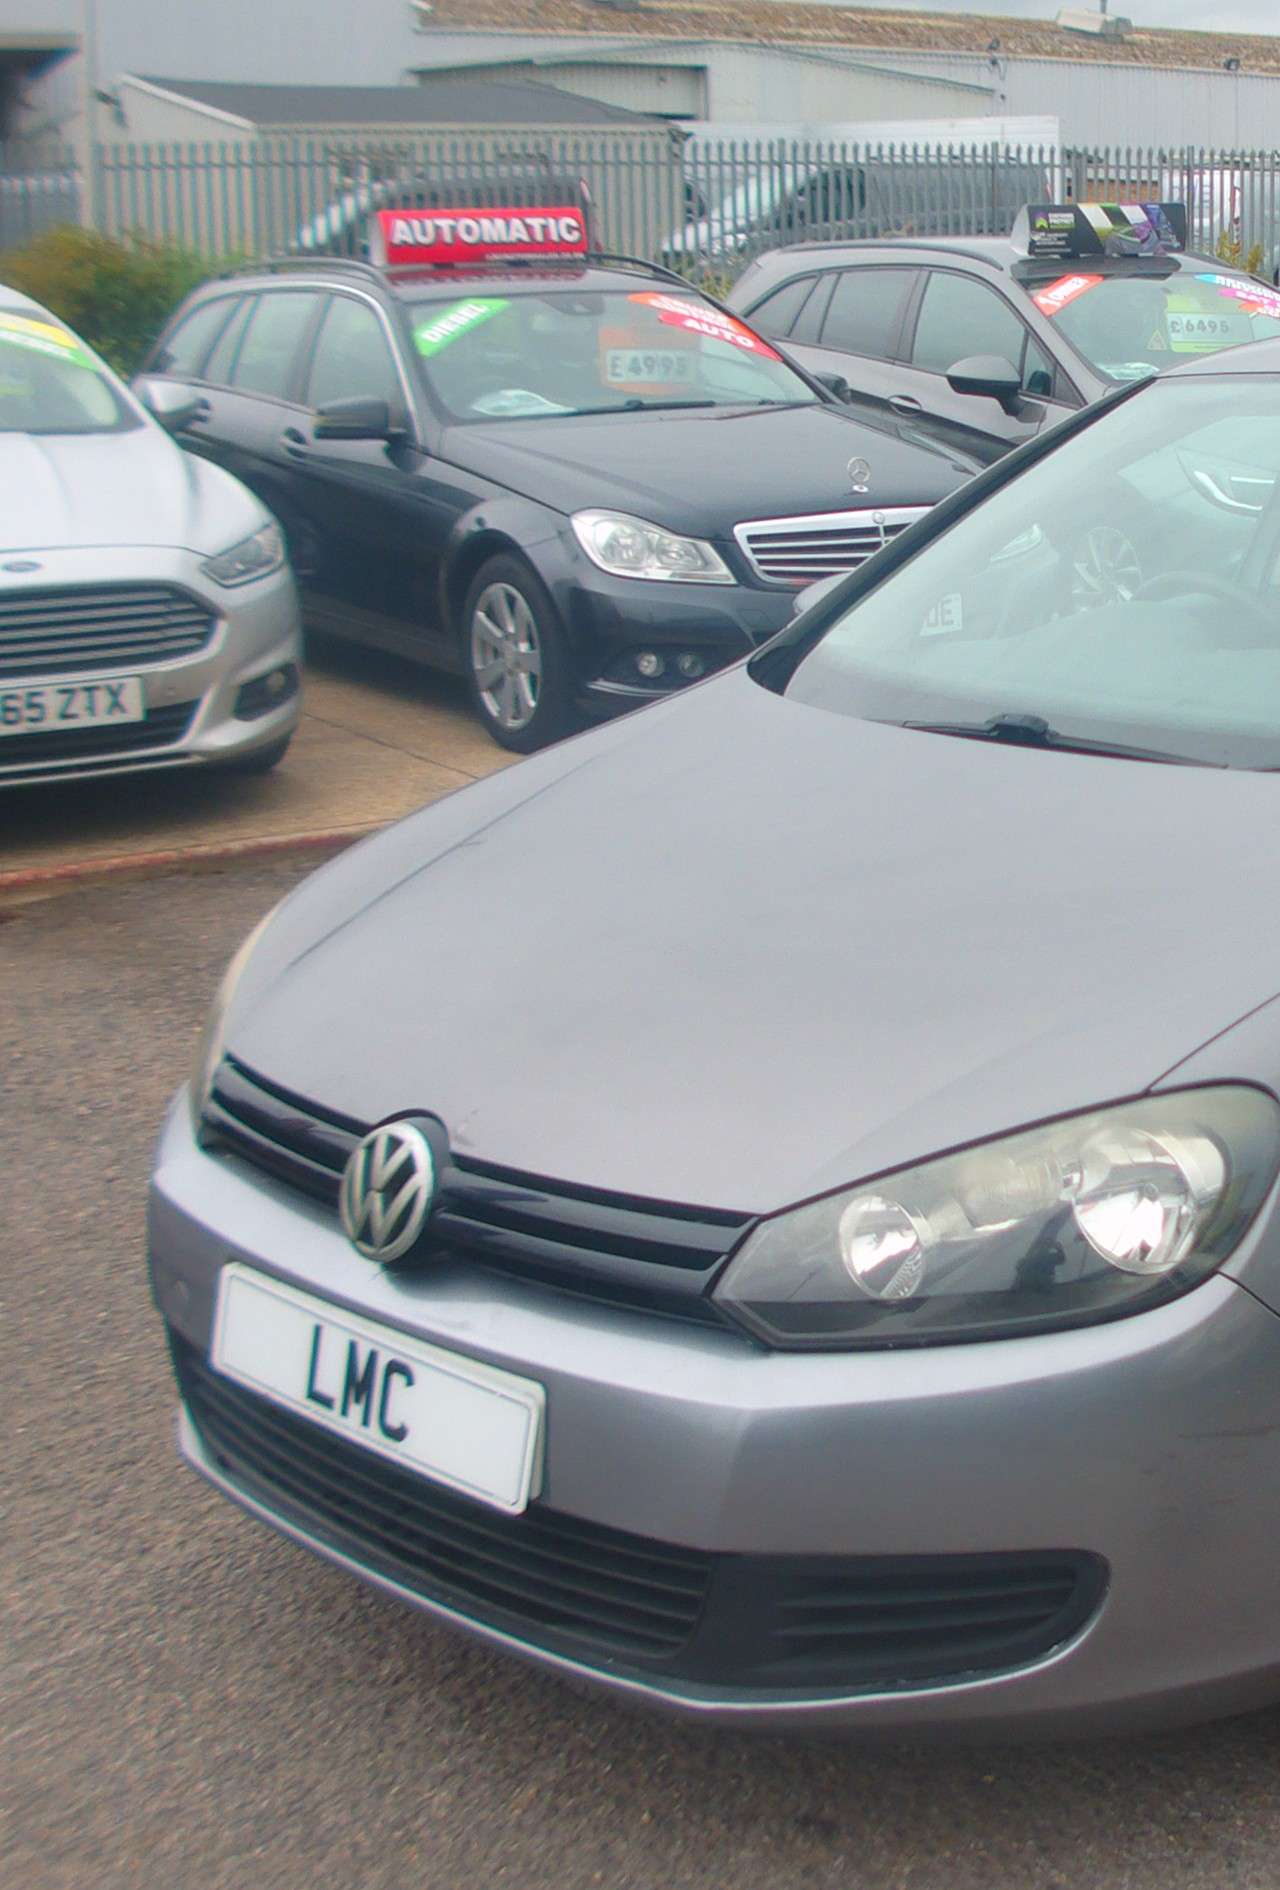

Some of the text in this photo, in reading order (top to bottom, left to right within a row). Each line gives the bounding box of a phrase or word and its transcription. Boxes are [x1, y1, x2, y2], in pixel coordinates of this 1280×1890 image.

[392, 216, 583, 245] AUTOMATIC
[683, 318, 754, 348] AUTO
[0, 683, 129, 726] 65 ZTX
[307, 1323, 414, 1443] LMC
